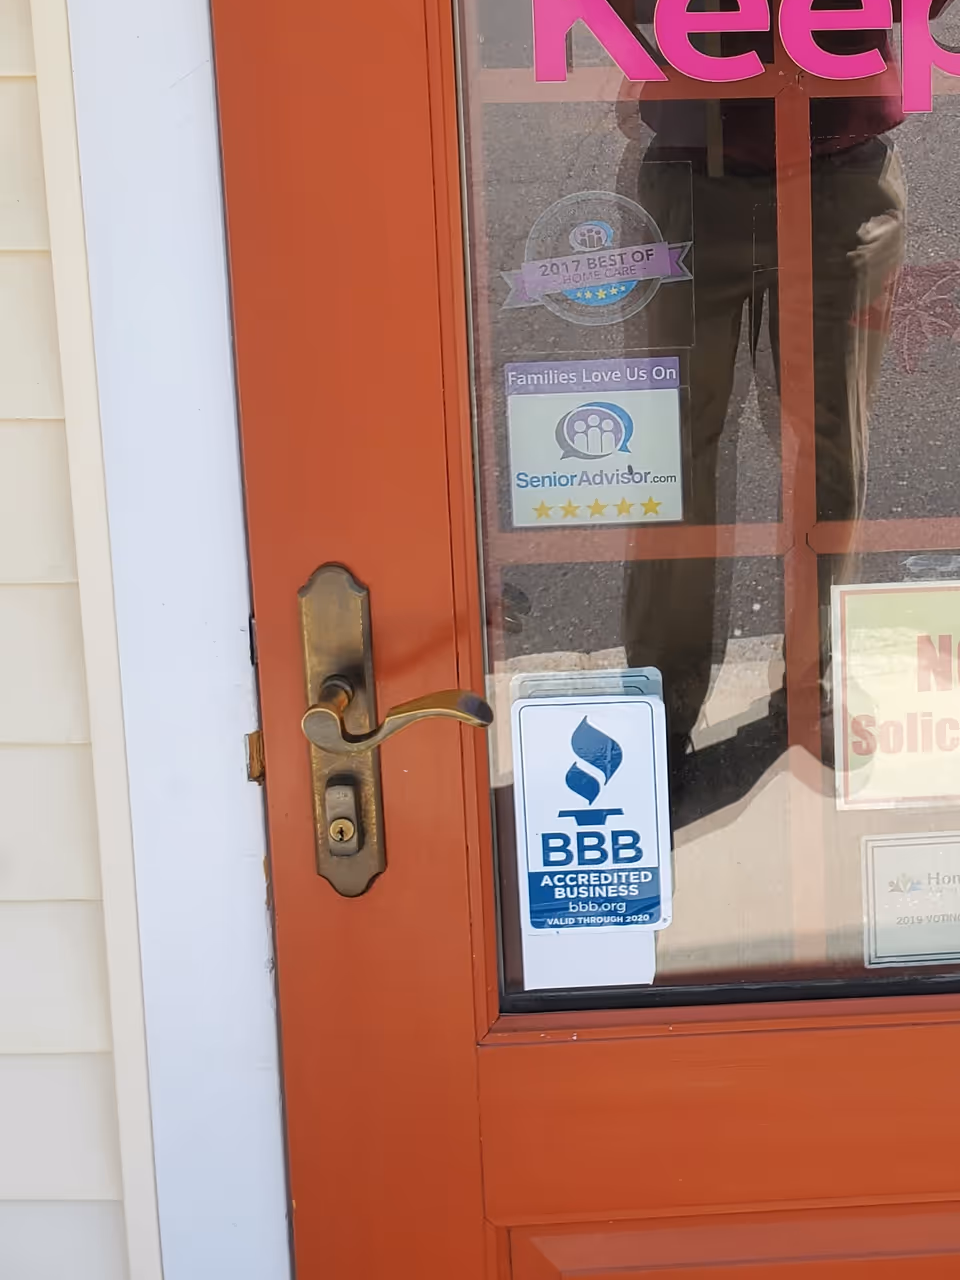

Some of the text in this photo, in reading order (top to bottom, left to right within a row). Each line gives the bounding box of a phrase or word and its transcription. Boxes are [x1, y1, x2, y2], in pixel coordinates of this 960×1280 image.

[538, 248, 655, 278] 2017 BEST OF
[562, 264, 637, 285] HOME CARE
[507, 365, 677, 386] Families Love Us On
[516, 468, 677, 489] SeniorAdvisor.com
[541, 829, 644, 868] BBB
[539, 870, 653, 887] ACCREDITED
[554, 884, 640, 899] BUSINESS
[568, 900, 627, 914] bbb.org
[547, 914, 650, 926] VALID THROUGH 2020
[896, 915, 923, 926] 2019
